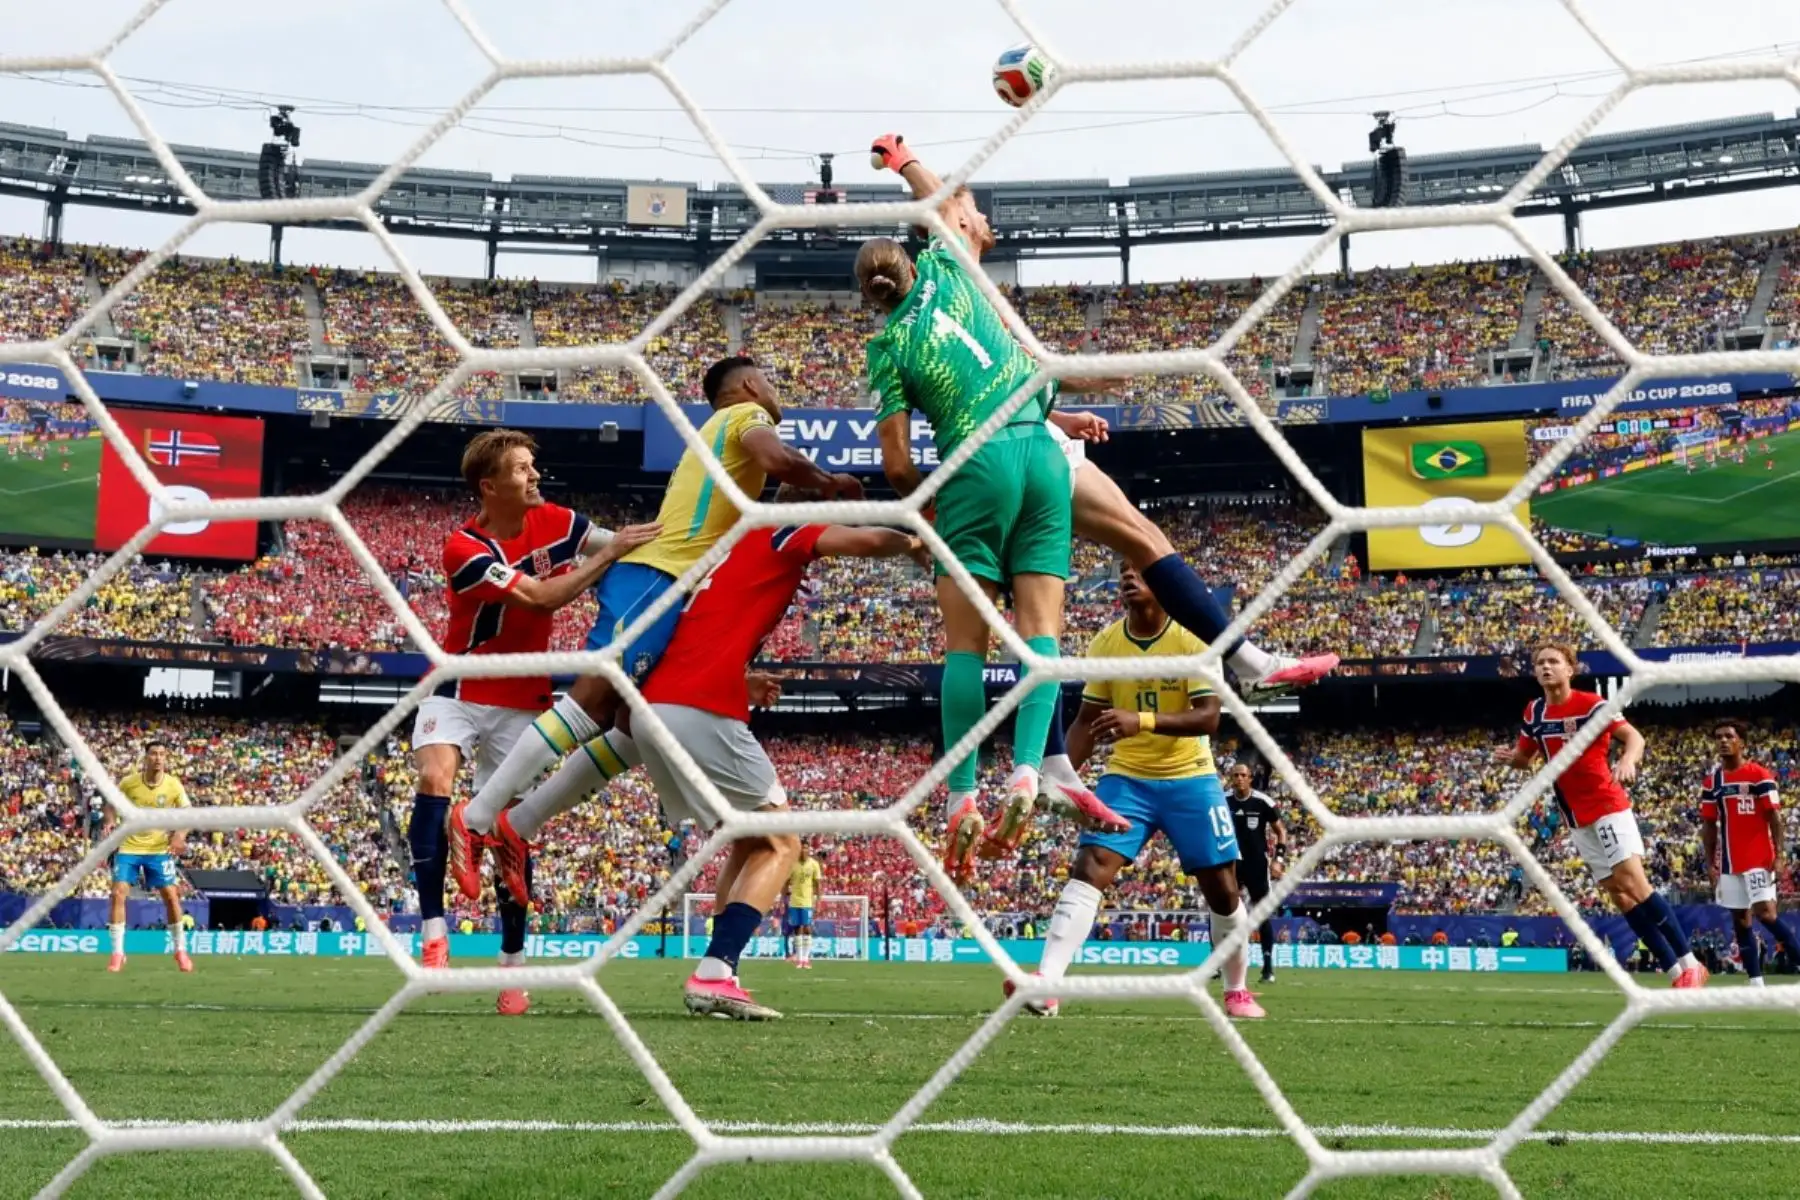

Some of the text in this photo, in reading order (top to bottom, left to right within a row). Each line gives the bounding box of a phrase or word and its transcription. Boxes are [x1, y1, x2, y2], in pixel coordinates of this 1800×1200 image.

[933, 307, 993, 369] 1
[8, 373, 58, 389] 2026
[1561, 382, 1732, 408] FIFA WLD CUP 2026
[776, 419, 936, 441] EW YR
[827, 447, 941, 465] JESE
[1645, 546, 1697, 557] Hisense
[212, 651, 267, 664] JESEY
[982, 668, 1016, 682] FIFA
[1135, 690, 1158, 713] 19
[1208, 805, 1235, 838] 19
[1599, 824, 1619, 848] 21
[308, 921, 343, 933] FA
[6, 933, 99, 953] sense
[523, 934, 640, 957] isene
[878, 936, 980, 962] 中国第一
[1074, 945, 1180, 965] isense
[1421, 946, 1527, 971] 中国第一
